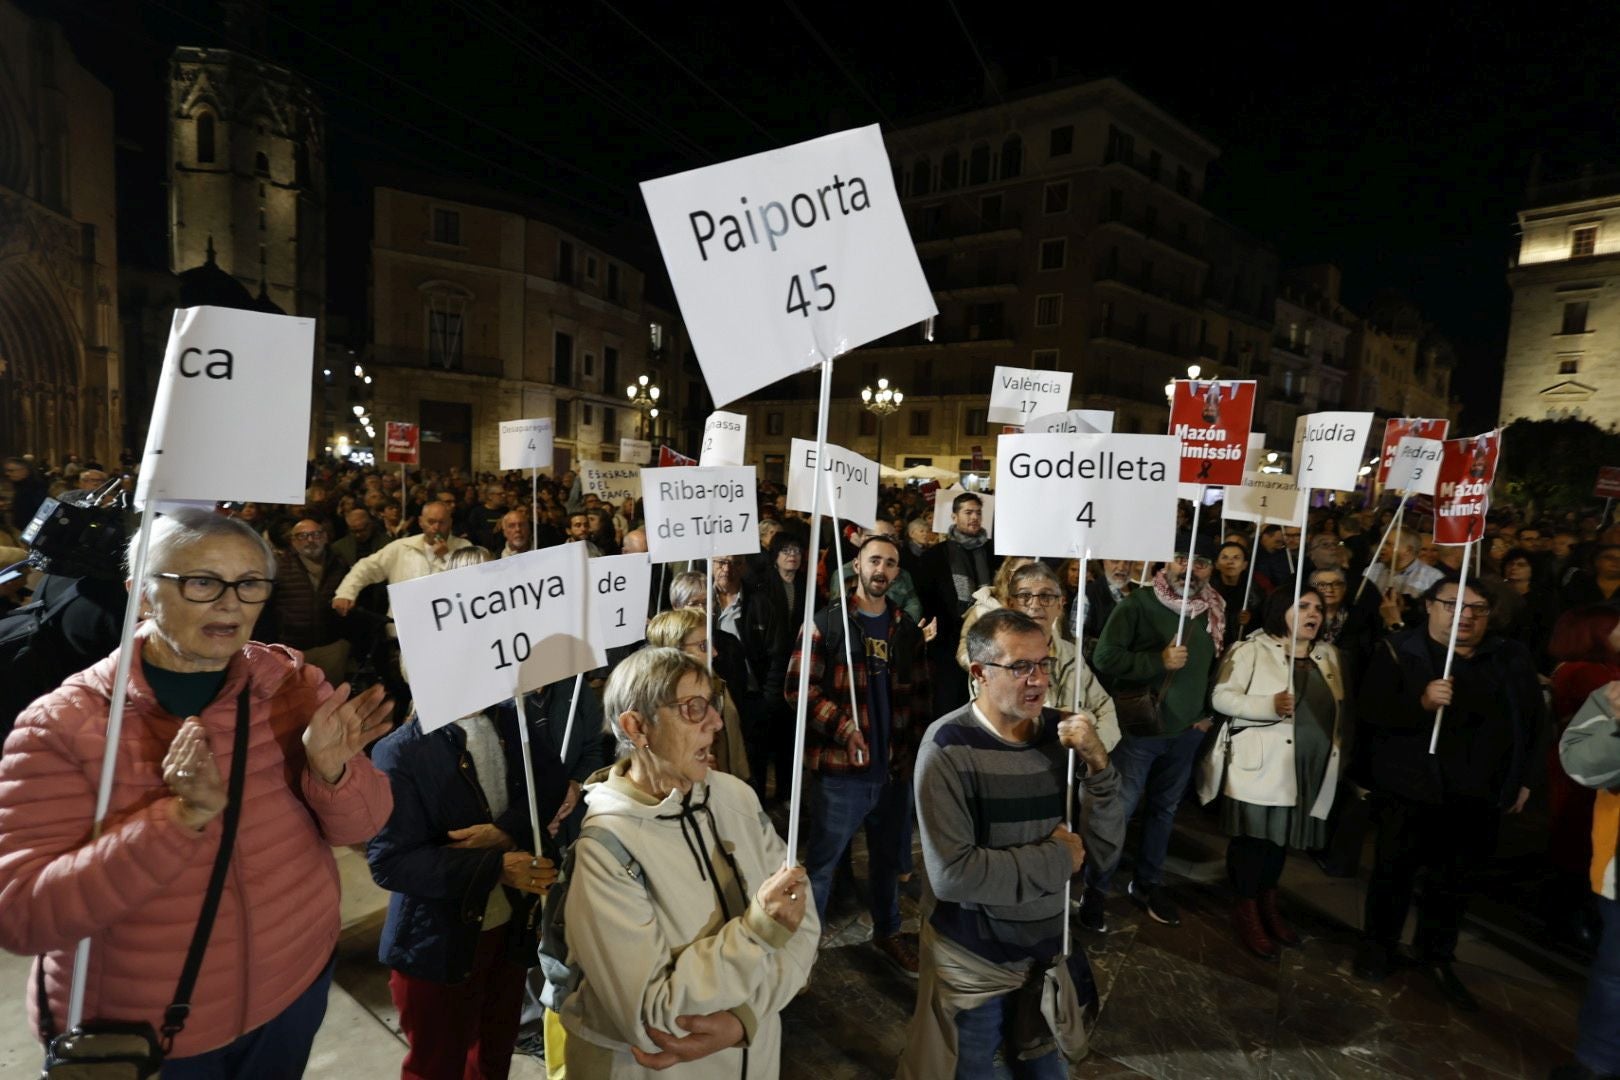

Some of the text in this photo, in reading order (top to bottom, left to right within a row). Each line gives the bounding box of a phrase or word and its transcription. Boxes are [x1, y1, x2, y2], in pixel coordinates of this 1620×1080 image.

[689, 174, 871, 261] Paiporta
[786, 264, 836, 317] 45
[1002, 376, 1061, 393] València
[1020, 400, 1038, 413] 17
[1175, 424, 1226, 441] Mazón
[528, 438, 536, 451] 4
[1009, 451, 1166, 481] Godelleta
[1306, 455, 1314, 471] 2
[1411, 468, 1423, 480] 3
[589, 481, 610, 490] DEL
[601, 490, 631, 499] FANG
[660, 480, 744, 502] Riba-roja
[836, 486, 842, 499] 1
[1259, 495, 1268, 507] 1
[1076, 501, 1096, 528] 4
[657, 513, 750, 539] de Túria 7
[598, 571, 627, 593] de
[431, 574, 565, 631] Picanya
[614, 608, 626, 627] 1
[491, 632, 532, 670] 10
